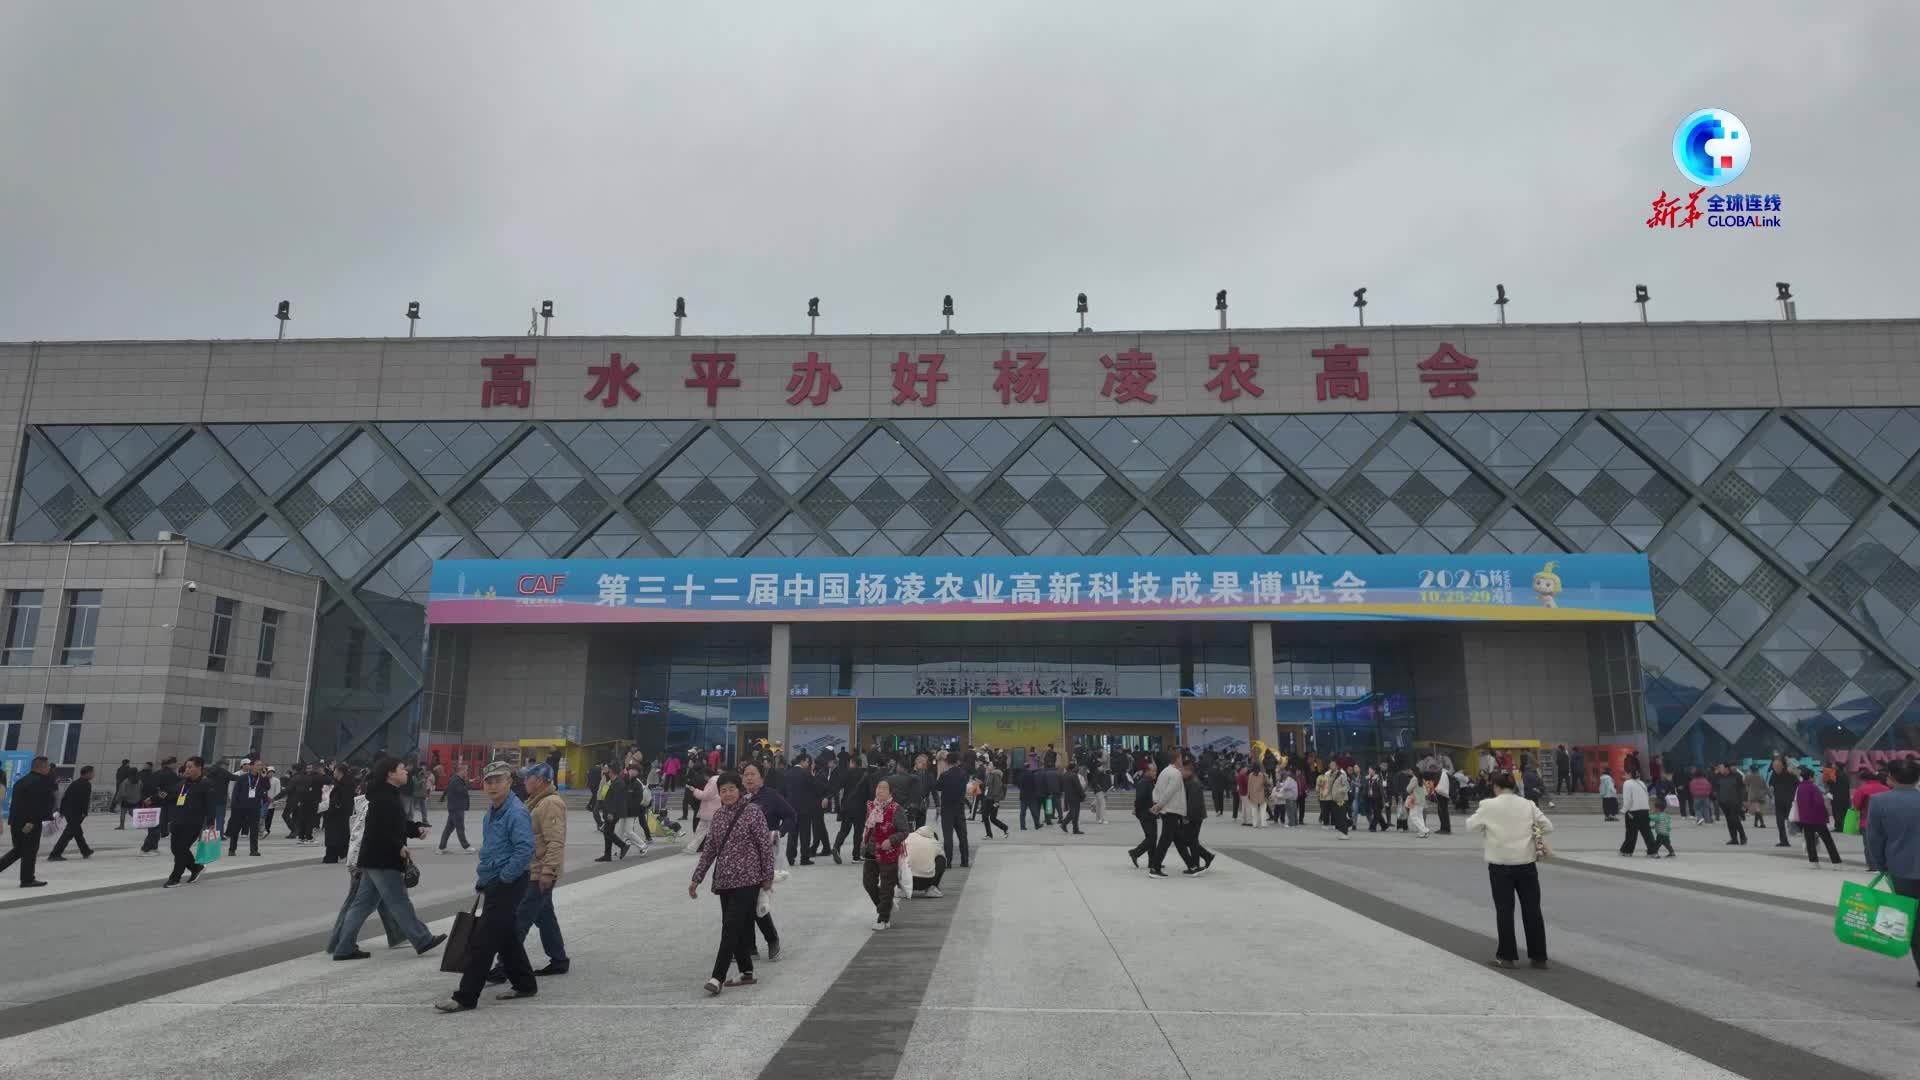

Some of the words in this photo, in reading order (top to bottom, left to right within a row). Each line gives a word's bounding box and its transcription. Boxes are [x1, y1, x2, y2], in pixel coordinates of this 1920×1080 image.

[481, 342, 1479, 408] 高水平办好杨凌农高会
[516, 573, 566, 595] CAF
[595, 569, 1369, 607] 第三十二届中国杨凌农业高新科技成果博览会
[1418, 569, 1490, 589] 2025
